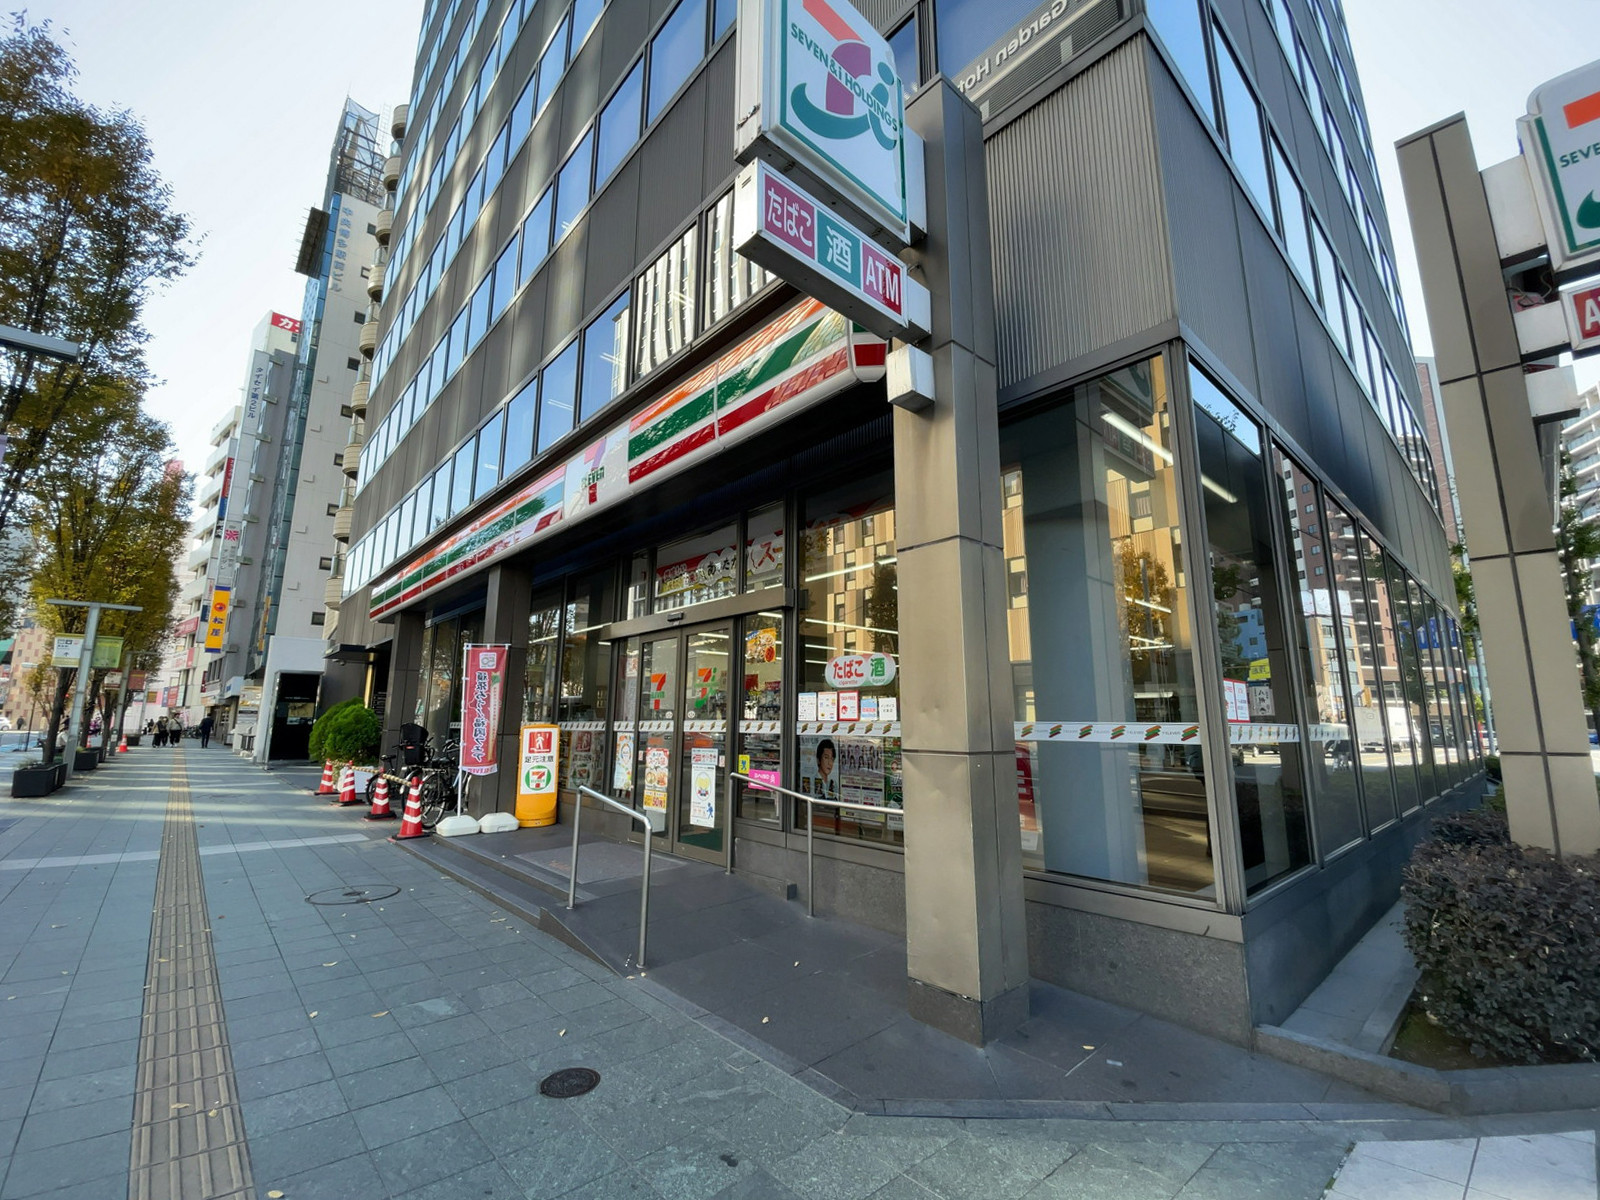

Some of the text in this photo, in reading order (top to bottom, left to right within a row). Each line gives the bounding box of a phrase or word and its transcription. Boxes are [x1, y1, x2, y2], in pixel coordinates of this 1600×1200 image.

[844, 72, 898, 132] HOLDINGS
[767, 187, 900, 306] たばこ 酒 ATM
[211, 616, 224, 637] 松屋
[832, 657, 886, 679] たばこ 酒
[524, 755, 554, 764] 足元注意
